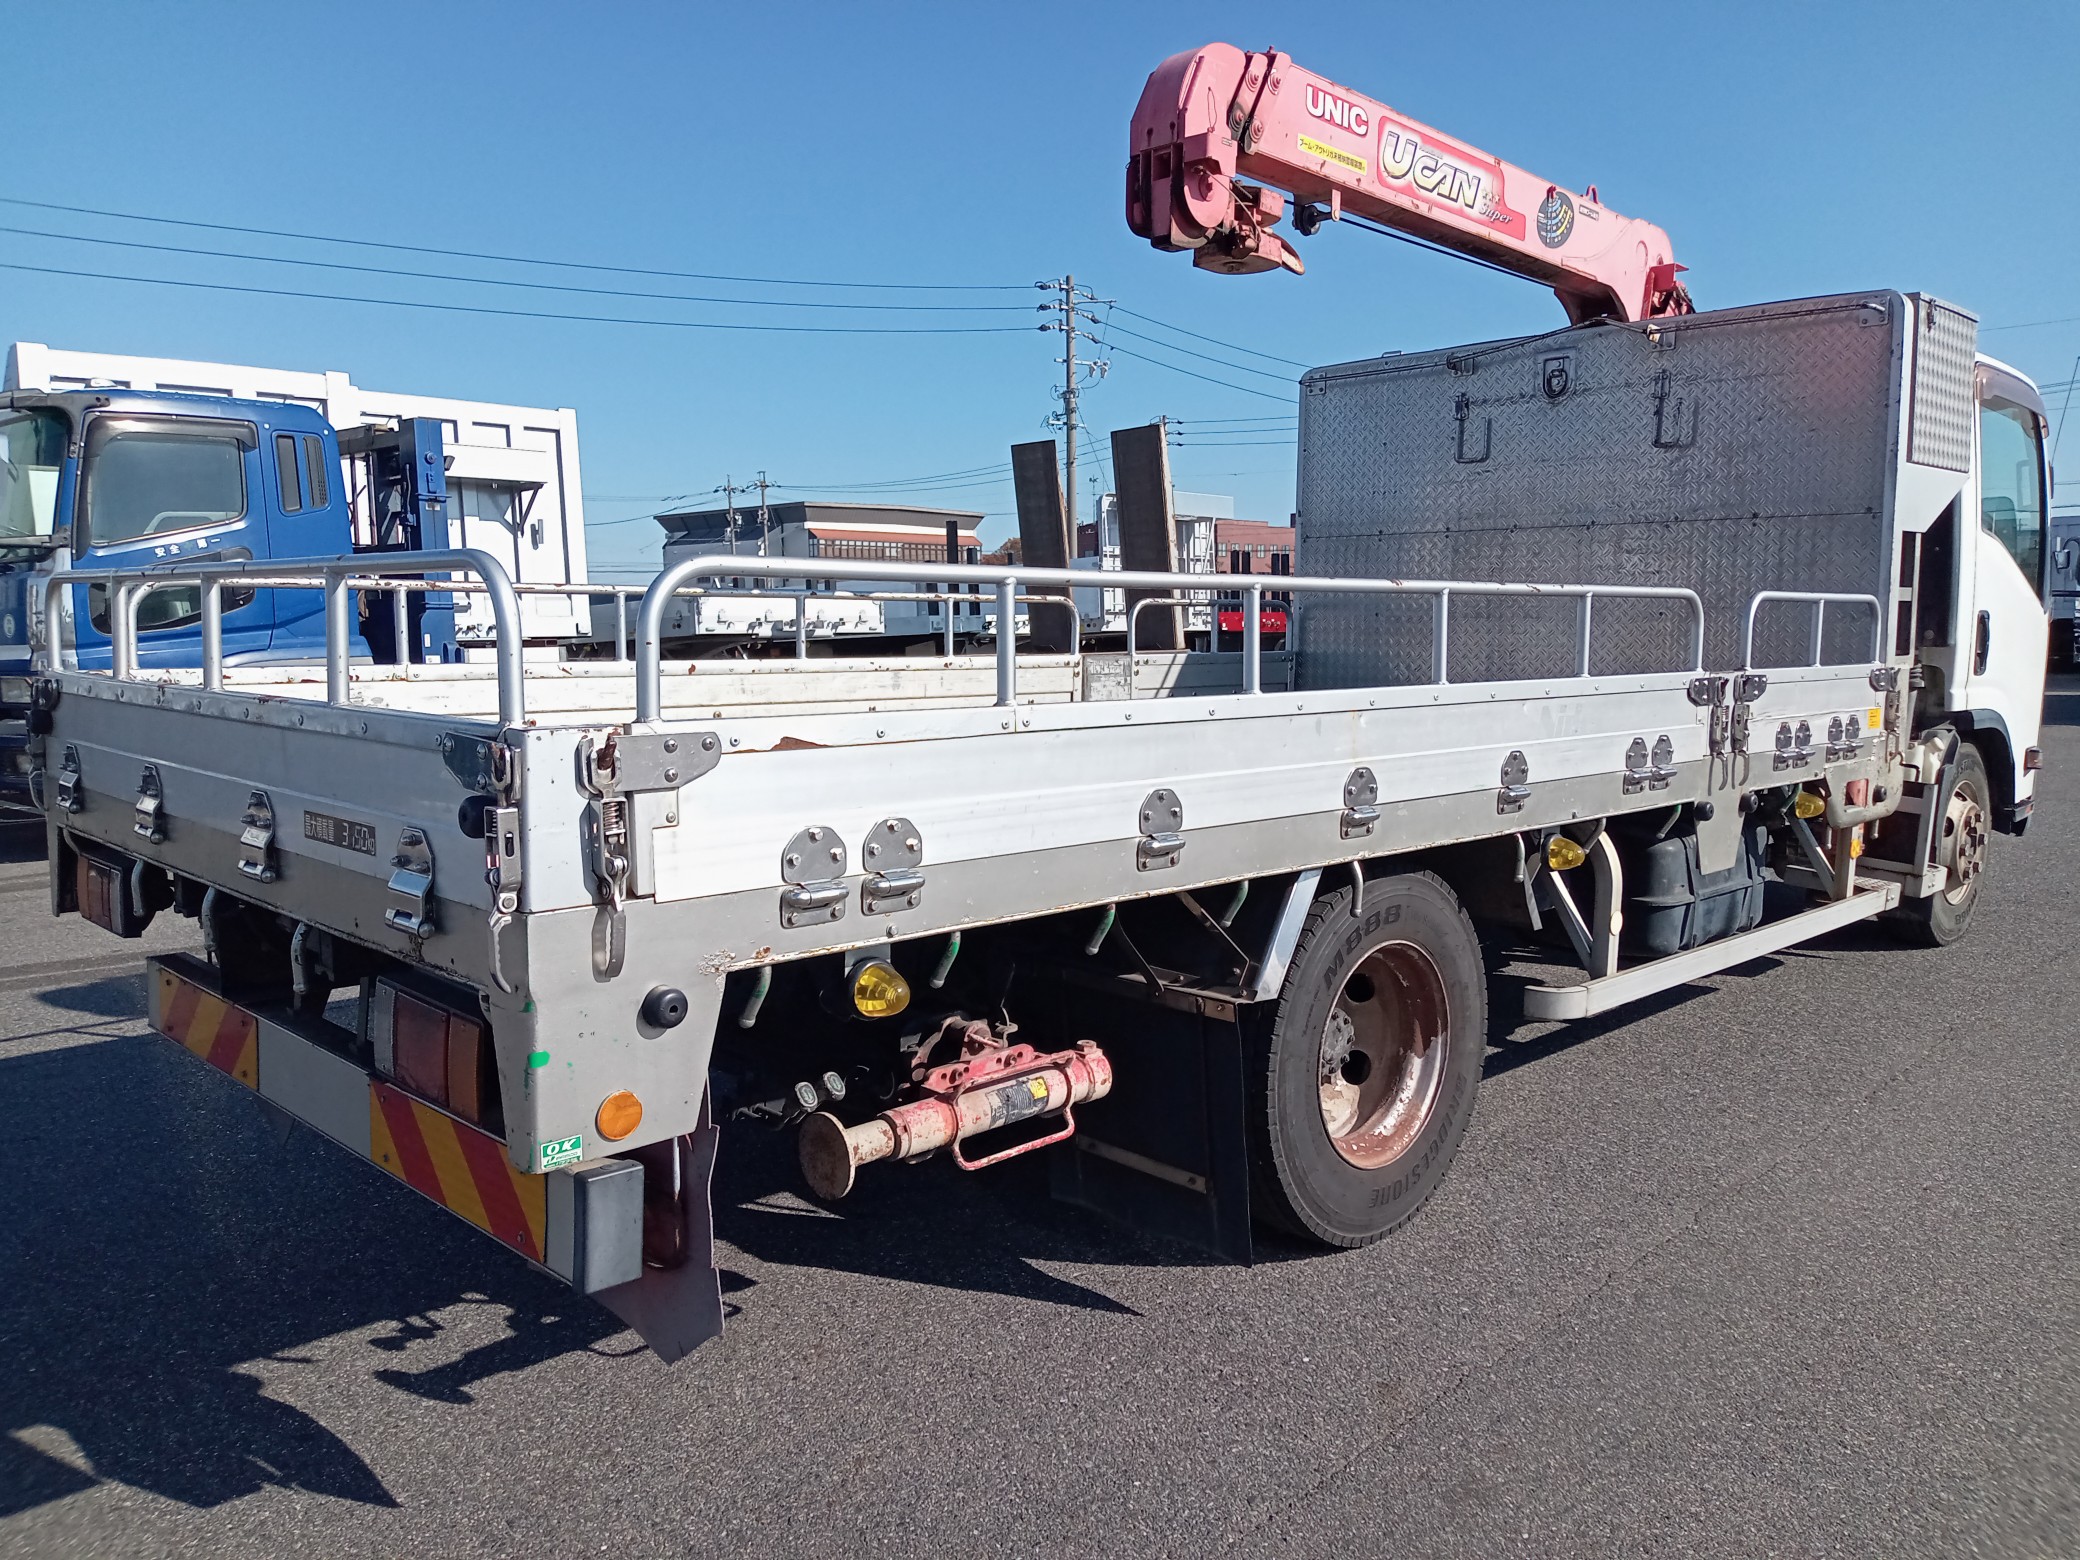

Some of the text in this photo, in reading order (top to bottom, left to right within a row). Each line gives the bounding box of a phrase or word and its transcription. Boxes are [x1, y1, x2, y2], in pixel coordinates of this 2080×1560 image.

[1306, 85, 1369, 136] UNIC
[1479, 203, 1513, 224] Super
[1323, 904, 1402, 991] M888
[546, 1138, 577, 1156] OK
